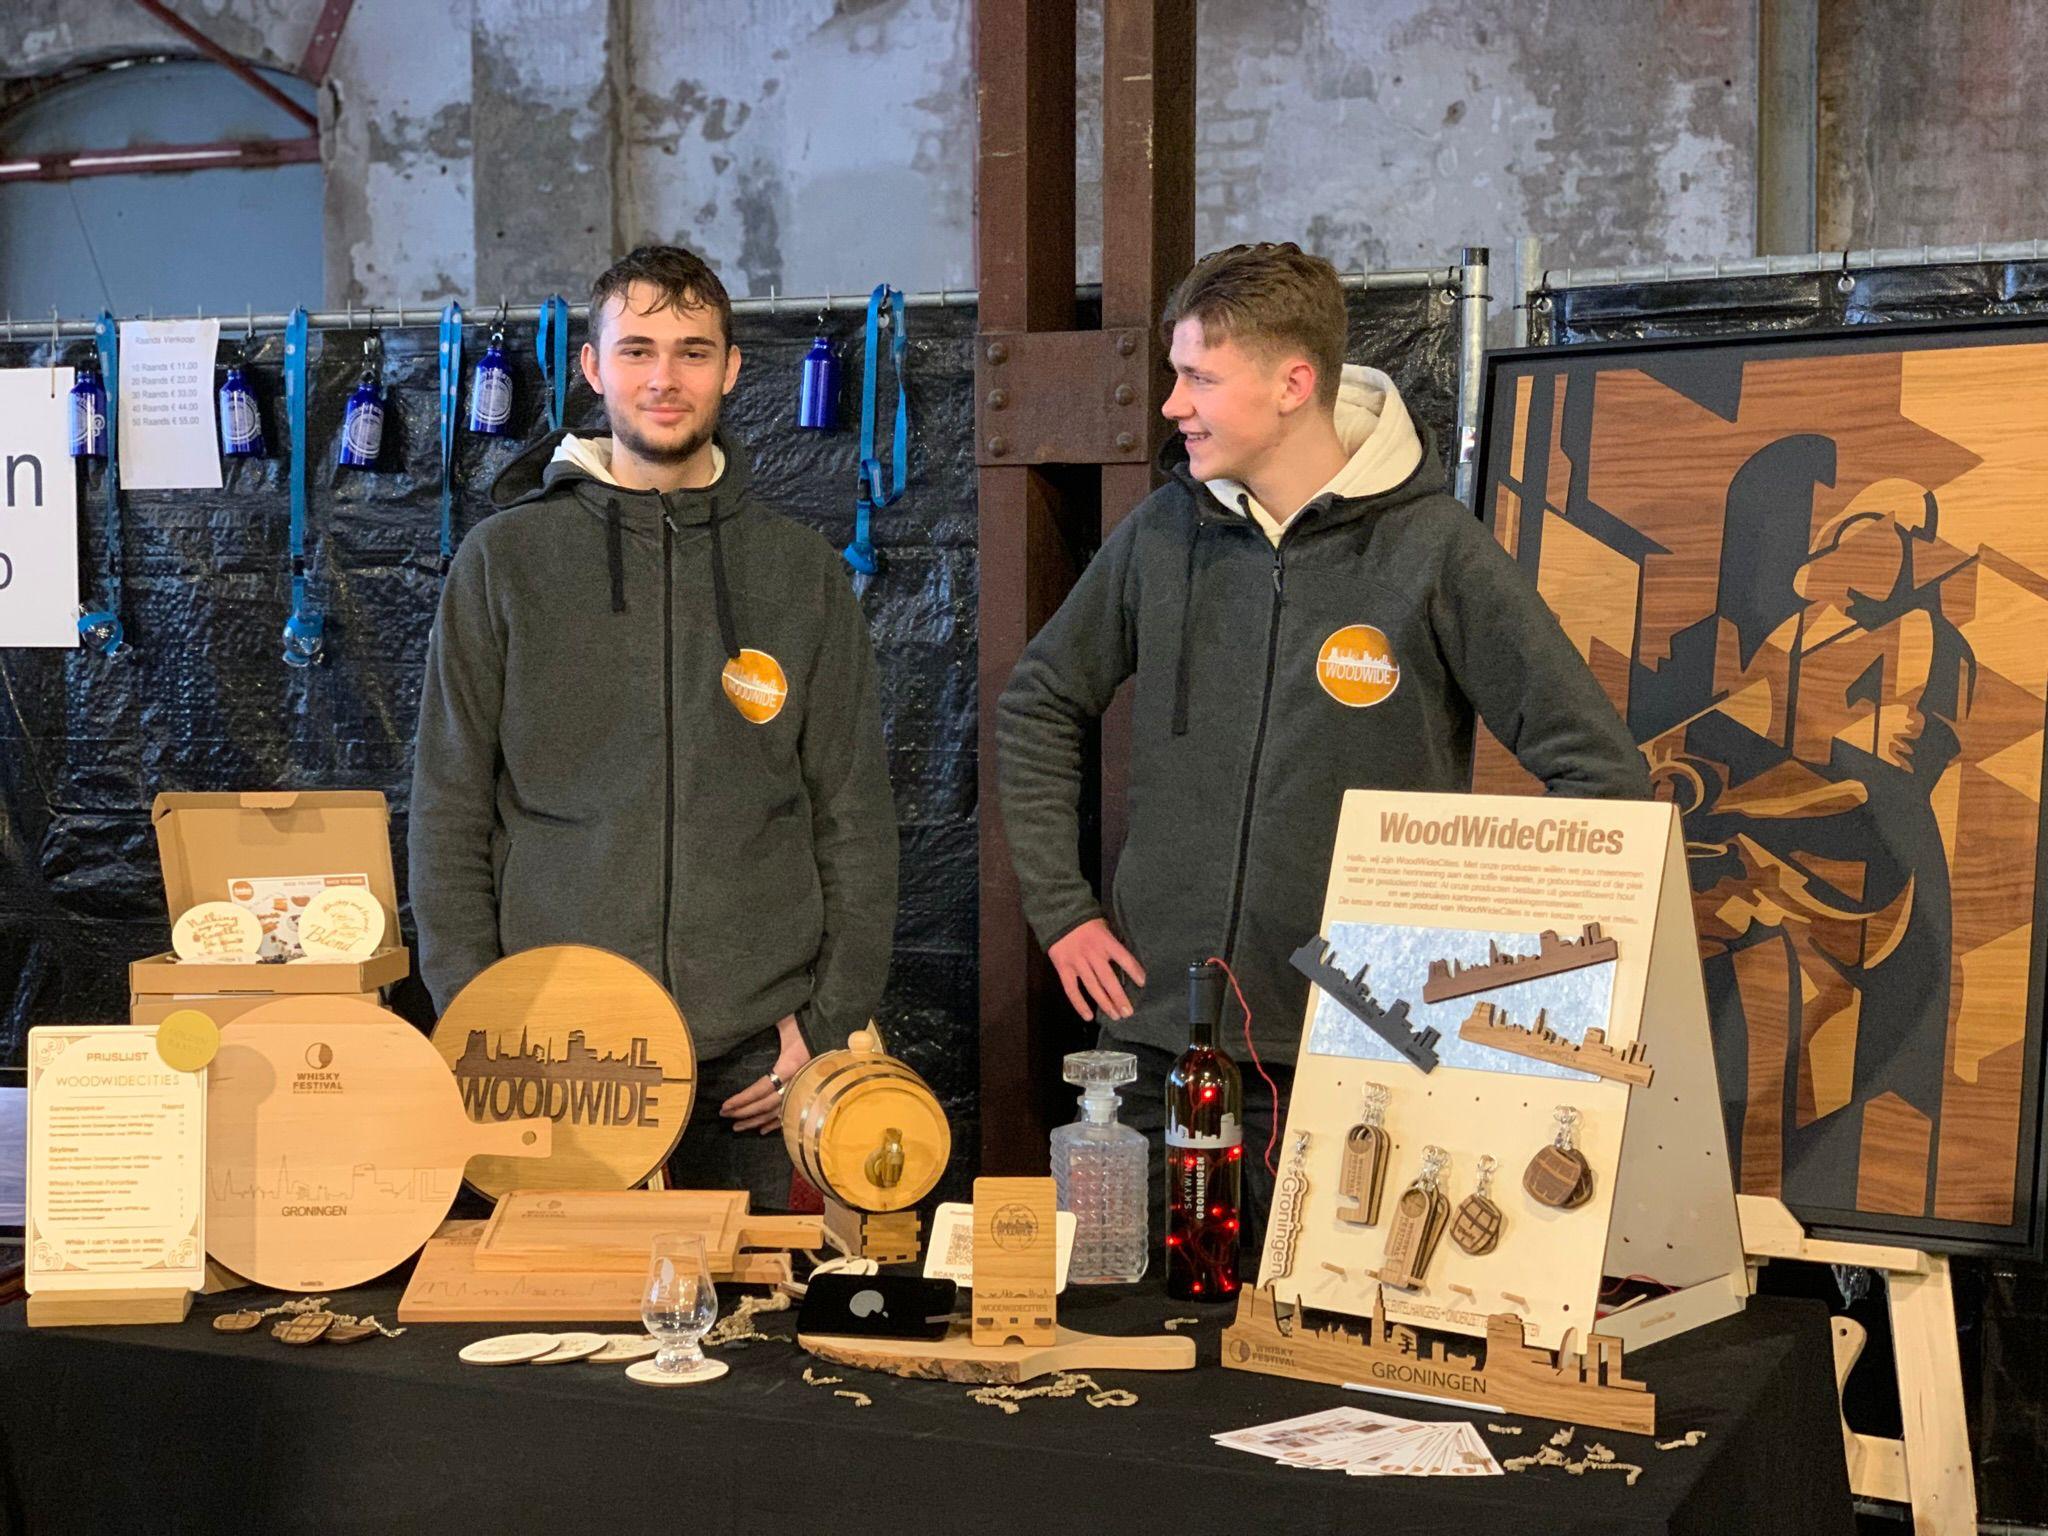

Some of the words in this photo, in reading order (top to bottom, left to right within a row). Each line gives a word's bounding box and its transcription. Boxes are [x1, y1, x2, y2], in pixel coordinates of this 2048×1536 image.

[1325, 661, 1391, 685] WOODWIDE
[1380, 811, 1624, 855] WoodWideCities
[1501, 863, 1541, 873] producten
[1471, 884, 1510, 894] producten
[56, 1074, 181, 1088] WOODWIDECITIES
[296, 1072, 340, 1081] WHISKY
[293, 1081, 344, 1090] FESTIVAL
[457, 1076, 659, 1128] WOODWIDE
[281, 1205, 347, 1217] GRONINGEN
[1271, 1176, 1298, 1274] Groningen
[1371, 1361, 1487, 1395] GRONINGEN
